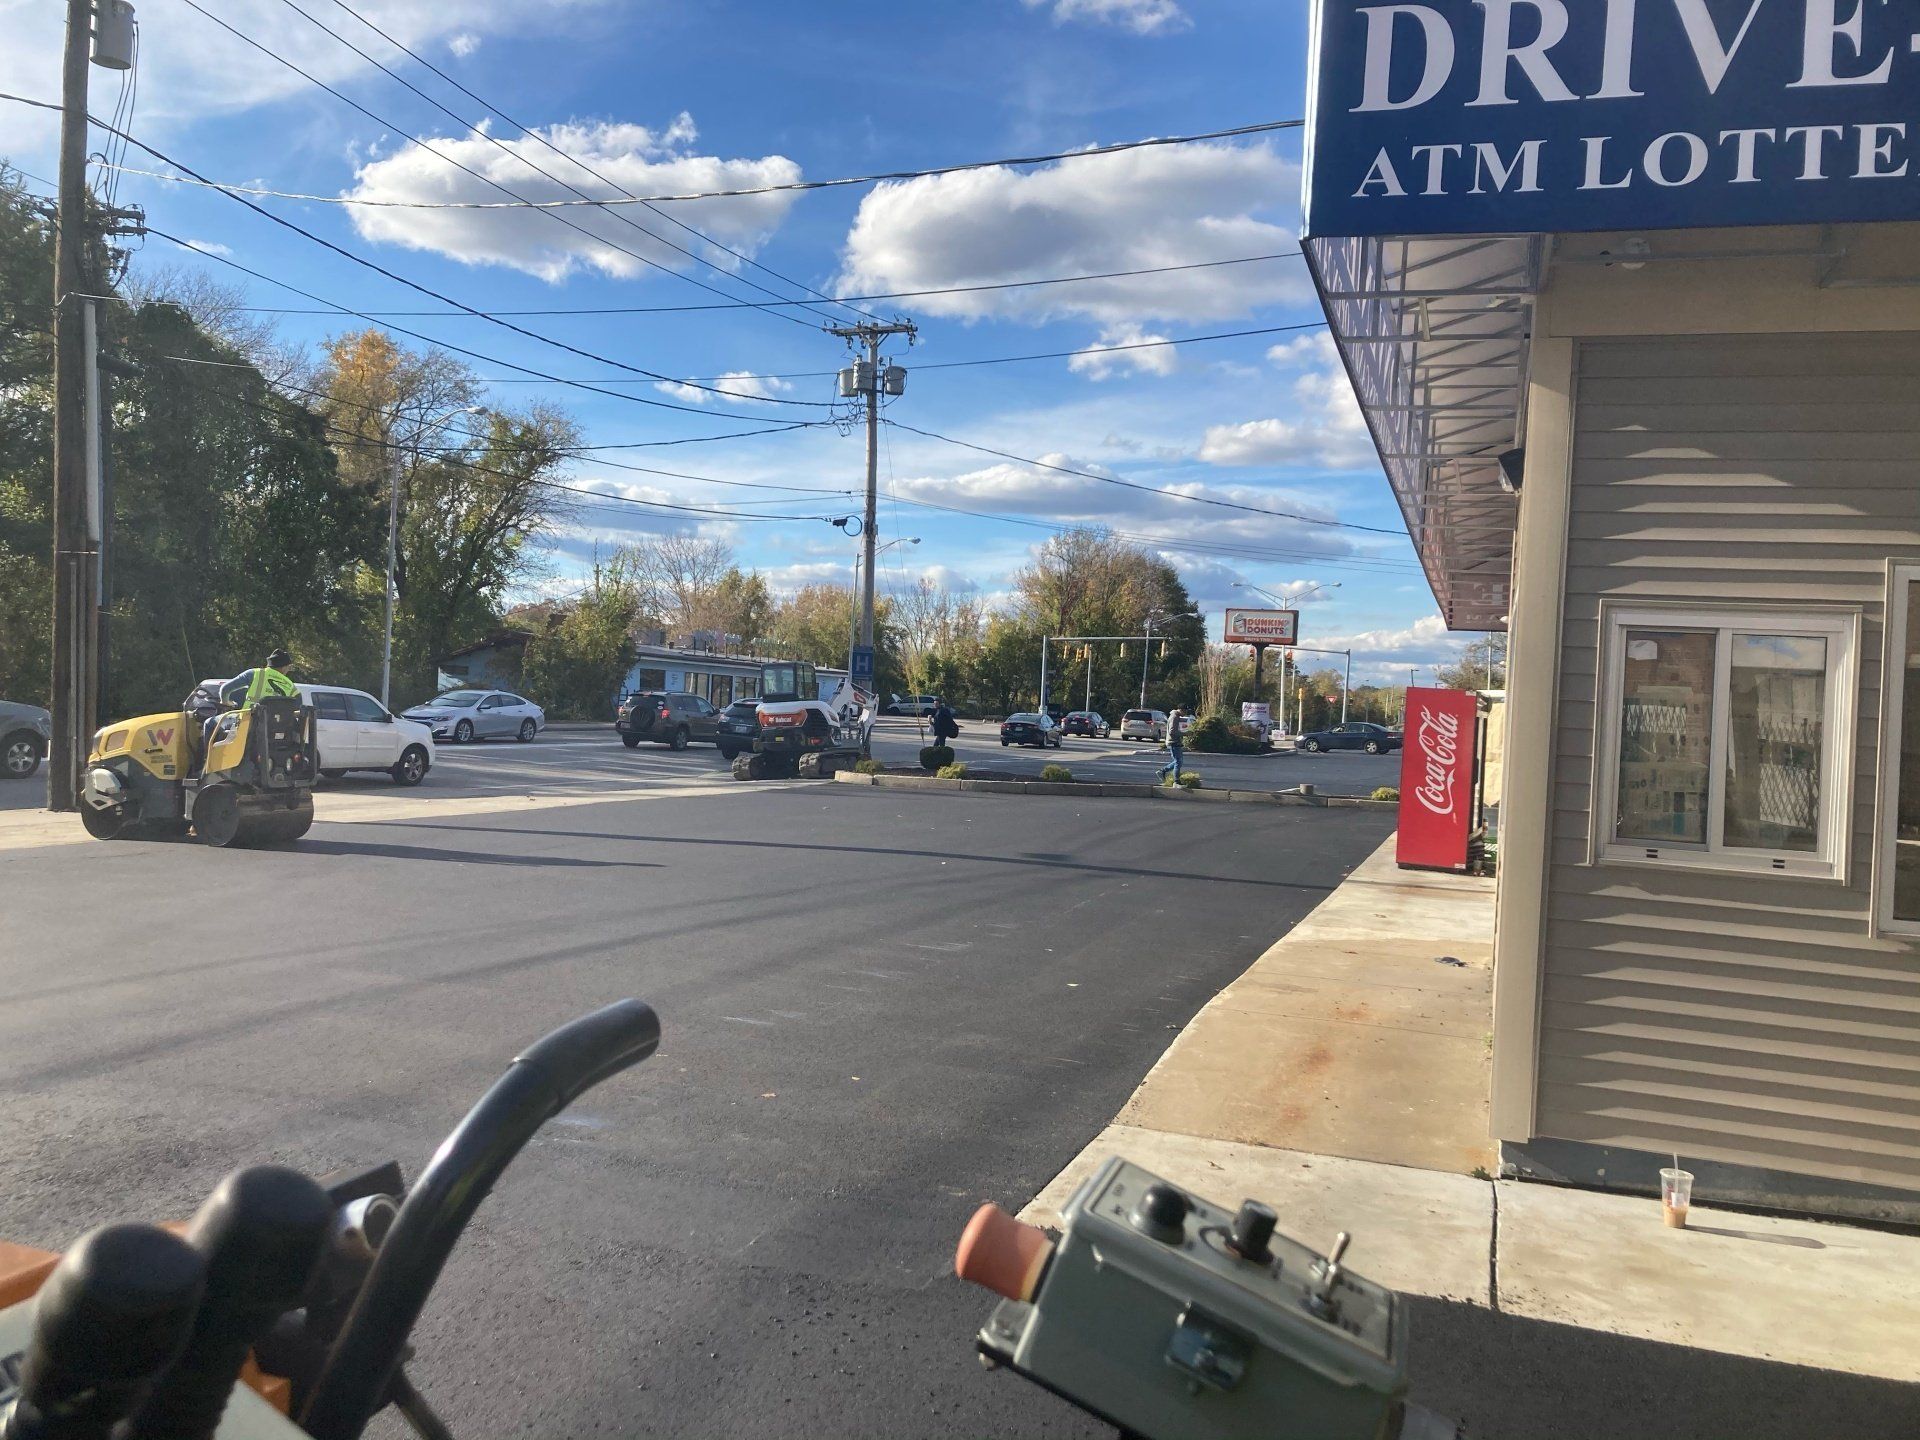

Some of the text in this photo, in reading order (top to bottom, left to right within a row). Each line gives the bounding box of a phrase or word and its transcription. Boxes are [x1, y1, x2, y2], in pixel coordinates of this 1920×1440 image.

[1351, 122, 1920, 197] ATM LOTTE
[1247, 626, 1284, 634] DONUTS
[856, 655, 869, 671] H
